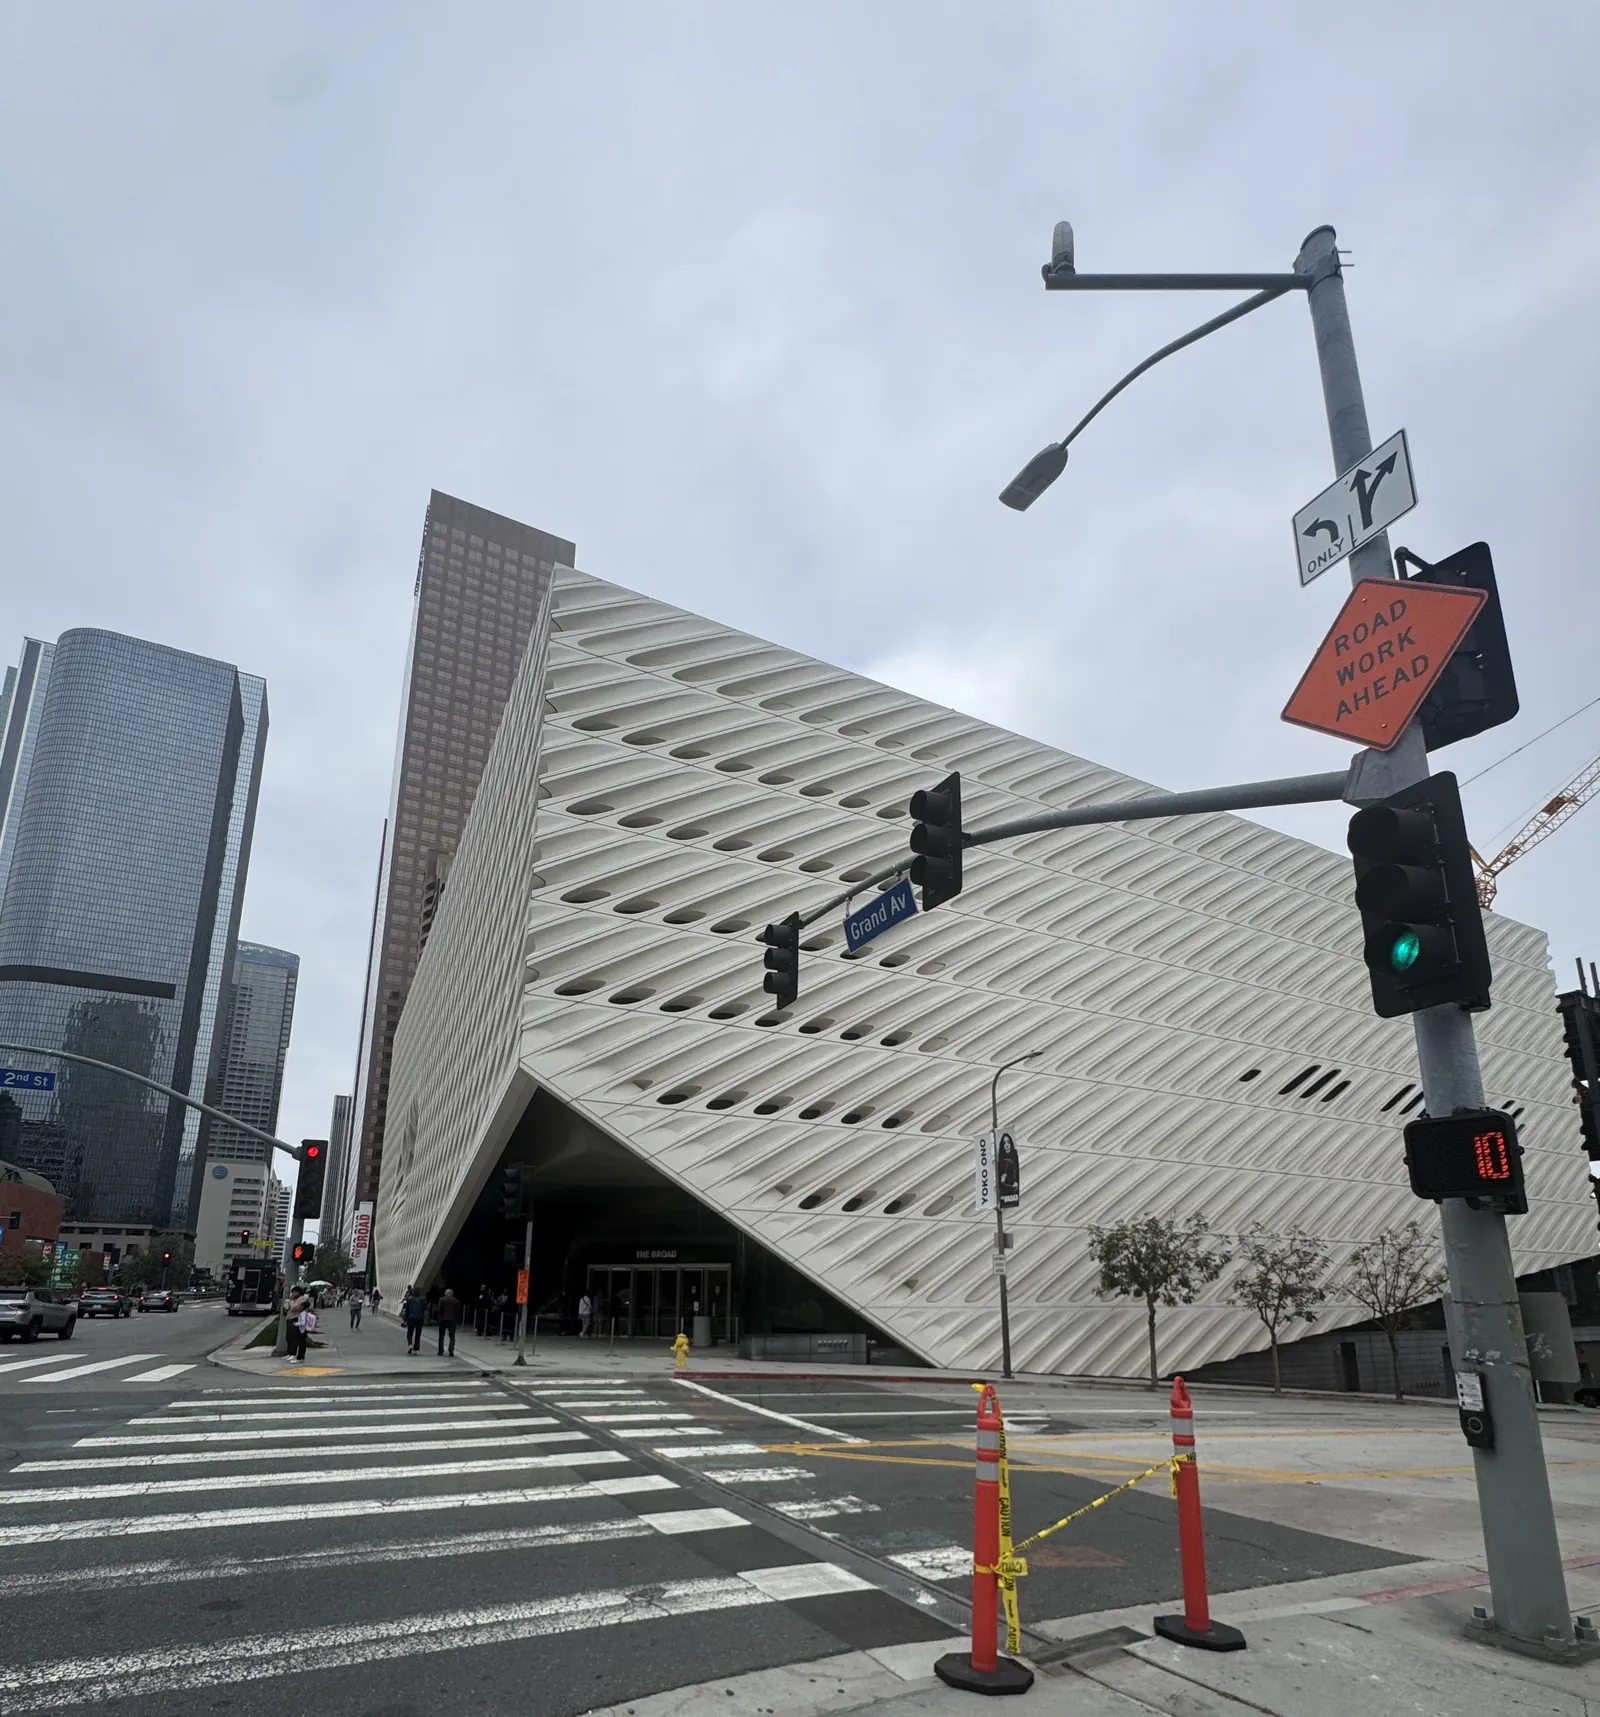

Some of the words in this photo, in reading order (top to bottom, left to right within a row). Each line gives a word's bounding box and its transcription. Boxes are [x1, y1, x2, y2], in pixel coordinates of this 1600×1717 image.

[1307, 537, 1345, 574] ONLY
[1334, 599, 1407, 657] ROAD
[1336, 625, 1416, 687] WORK
[1335, 654, 1429, 723] AHEAD
[850, 902, 888, 941] Grand
[890, 893, 906, 916] Av
[3, 1072, 30, 1085] 2nd
[33, 1075, 49, 1087] St
[979, 1139, 988, 1166] ONO
[1473, 1131, 1510, 1179] 10
[981, 1169, 989, 1205] YOKO
[356, 1214, 370, 1249] BROAD
[636, 1250, 651, 1259] THE
[651, 1250, 677, 1259] BROAD
[999, 1497, 1012, 1537] CAUTION
